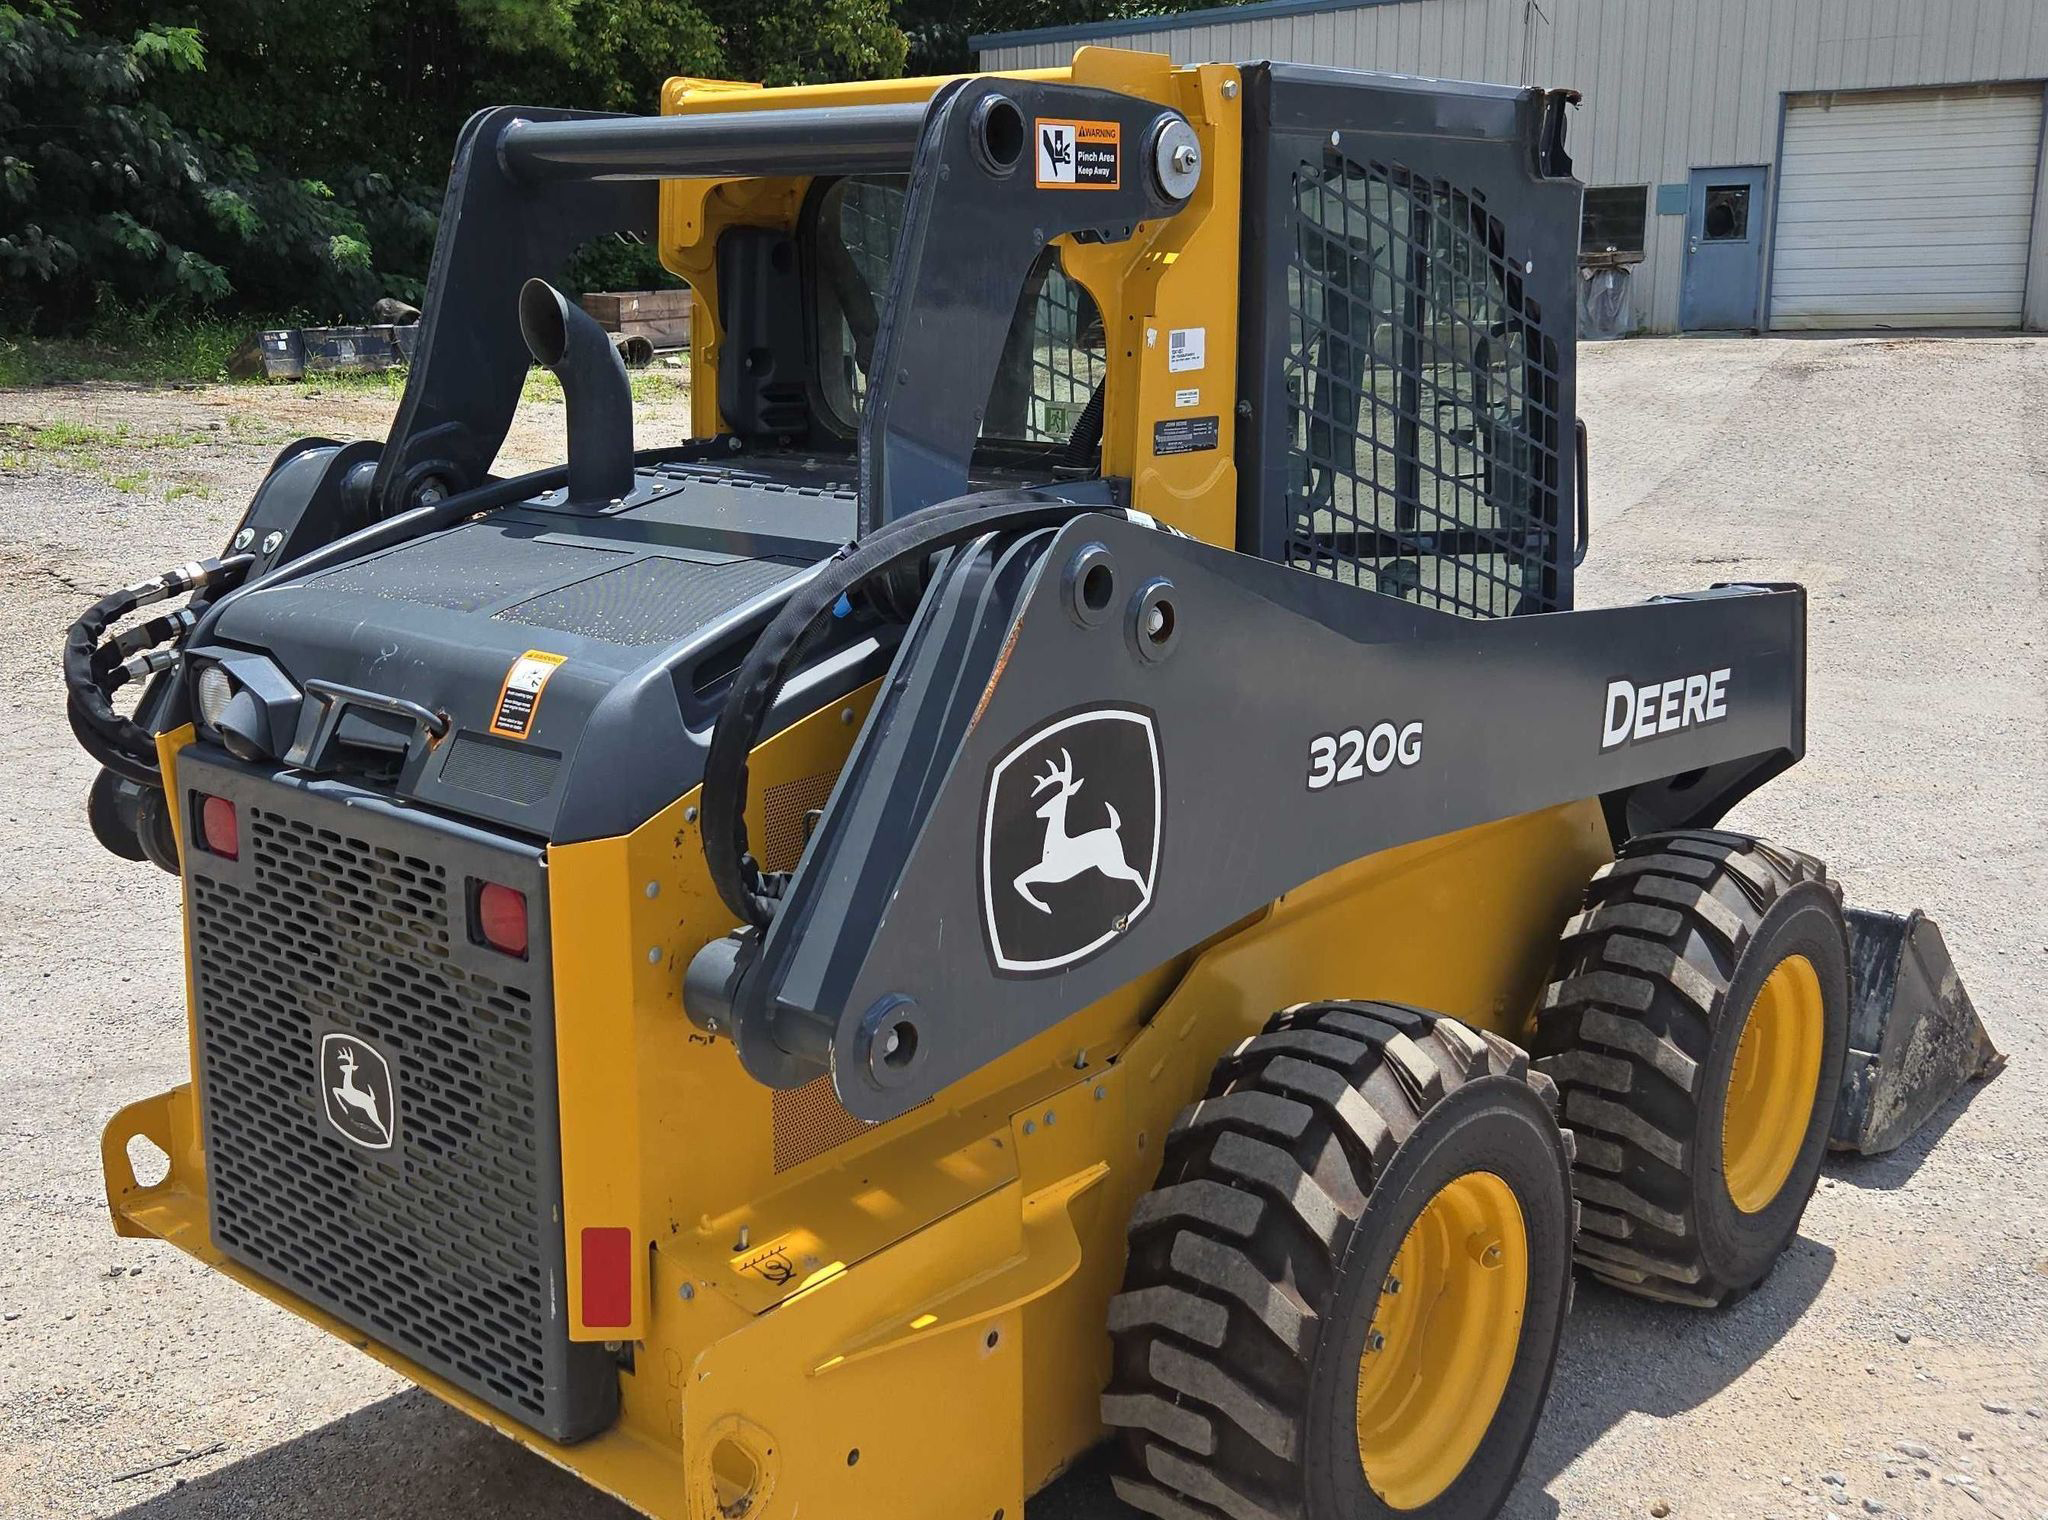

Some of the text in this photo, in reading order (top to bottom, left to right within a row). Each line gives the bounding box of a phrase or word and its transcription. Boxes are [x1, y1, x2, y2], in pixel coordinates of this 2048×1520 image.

[1085, 128, 1116, 138] WARNING
[1077, 151, 1115, 163] Pinch Area
[1077, 165, 1110, 178] Keep Away
[1602, 668, 1731, 748] DEERE
[1308, 722, 1423, 789] 320G
